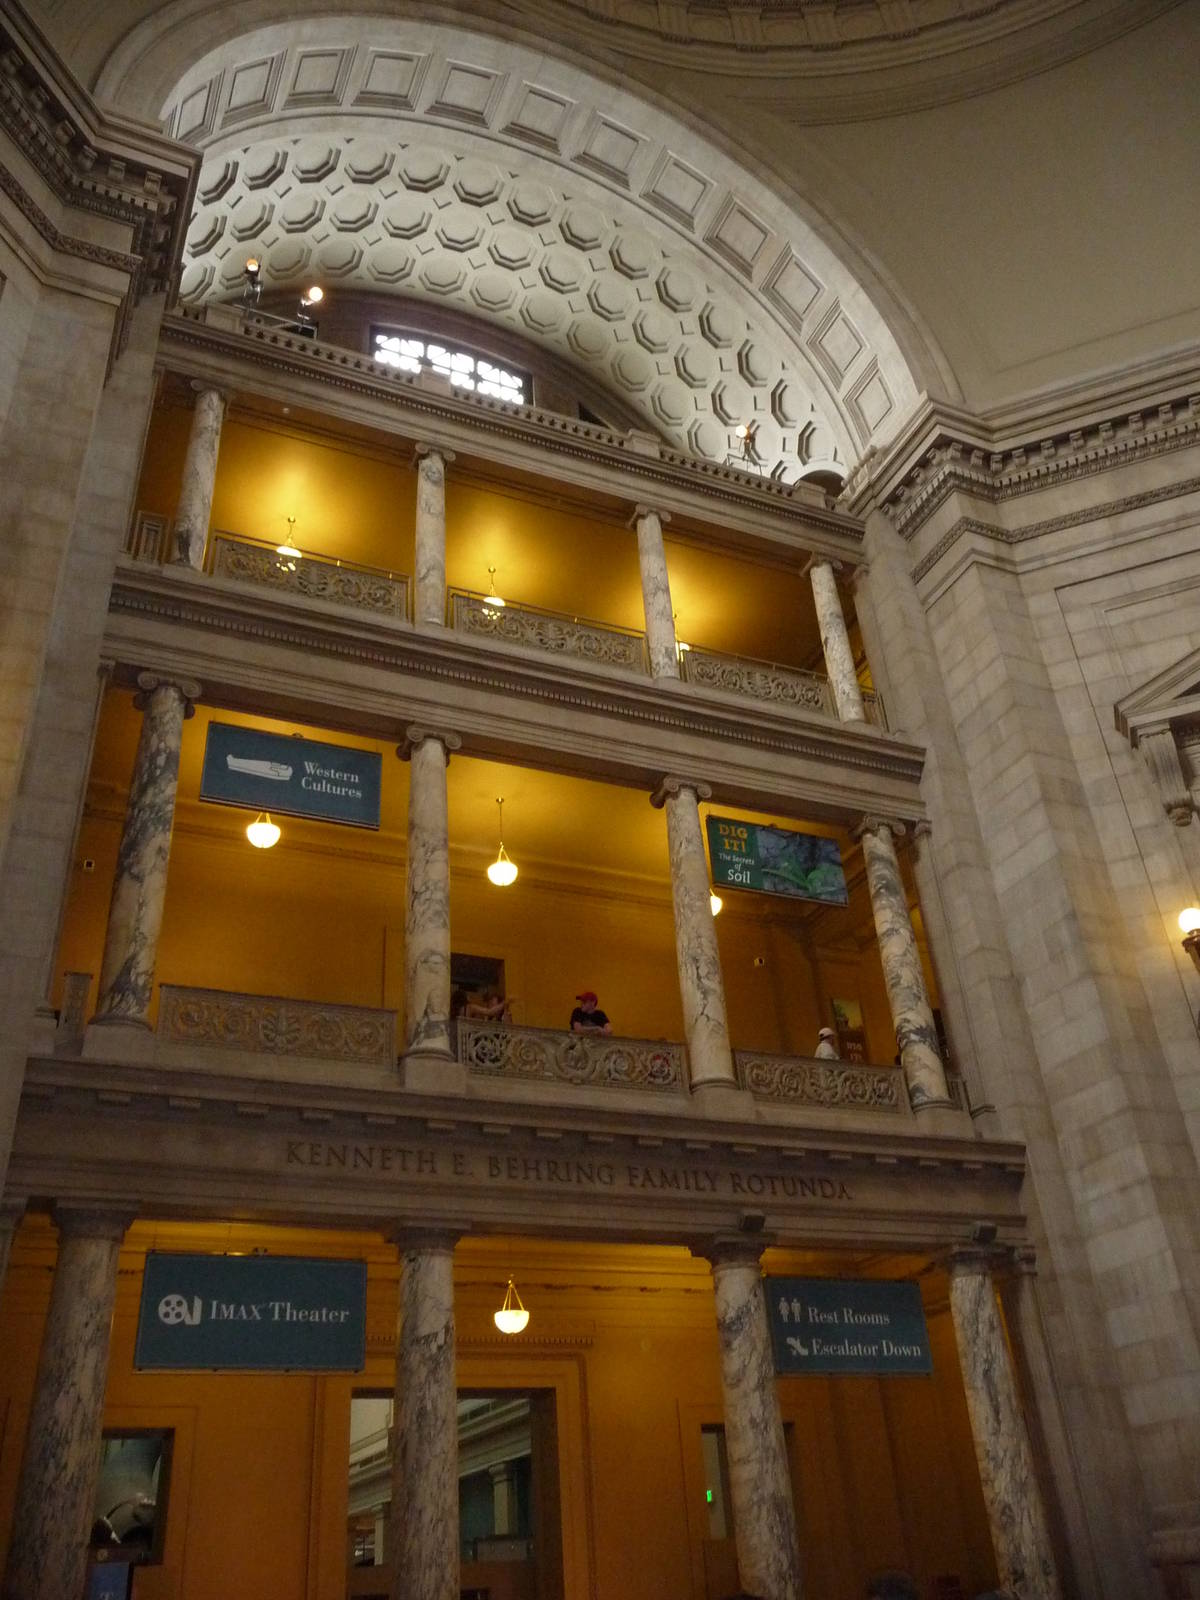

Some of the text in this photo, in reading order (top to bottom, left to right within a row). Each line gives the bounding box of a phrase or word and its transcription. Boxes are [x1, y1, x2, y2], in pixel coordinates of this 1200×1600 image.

[303, 760, 360, 783] Western
[301, 776, 362, 799] Cultures
[718, 823, 748, 840] DIG
[723, 838, 747, 853] IT!
[718, 852, 755, 865] The Secrets
[734, 863, 742, 871] of
[727, 868, 751, 884] Soil
[286, 1140, 854, 1201] KENNETH E. BEHRING FAMILY ROTUNDA
[209, 1299, 351, 1324] IMAX Theater
[807, 1306, 891, 1326] Rest Rooms
[811, 1337, 921, 1357] Escalator Down
